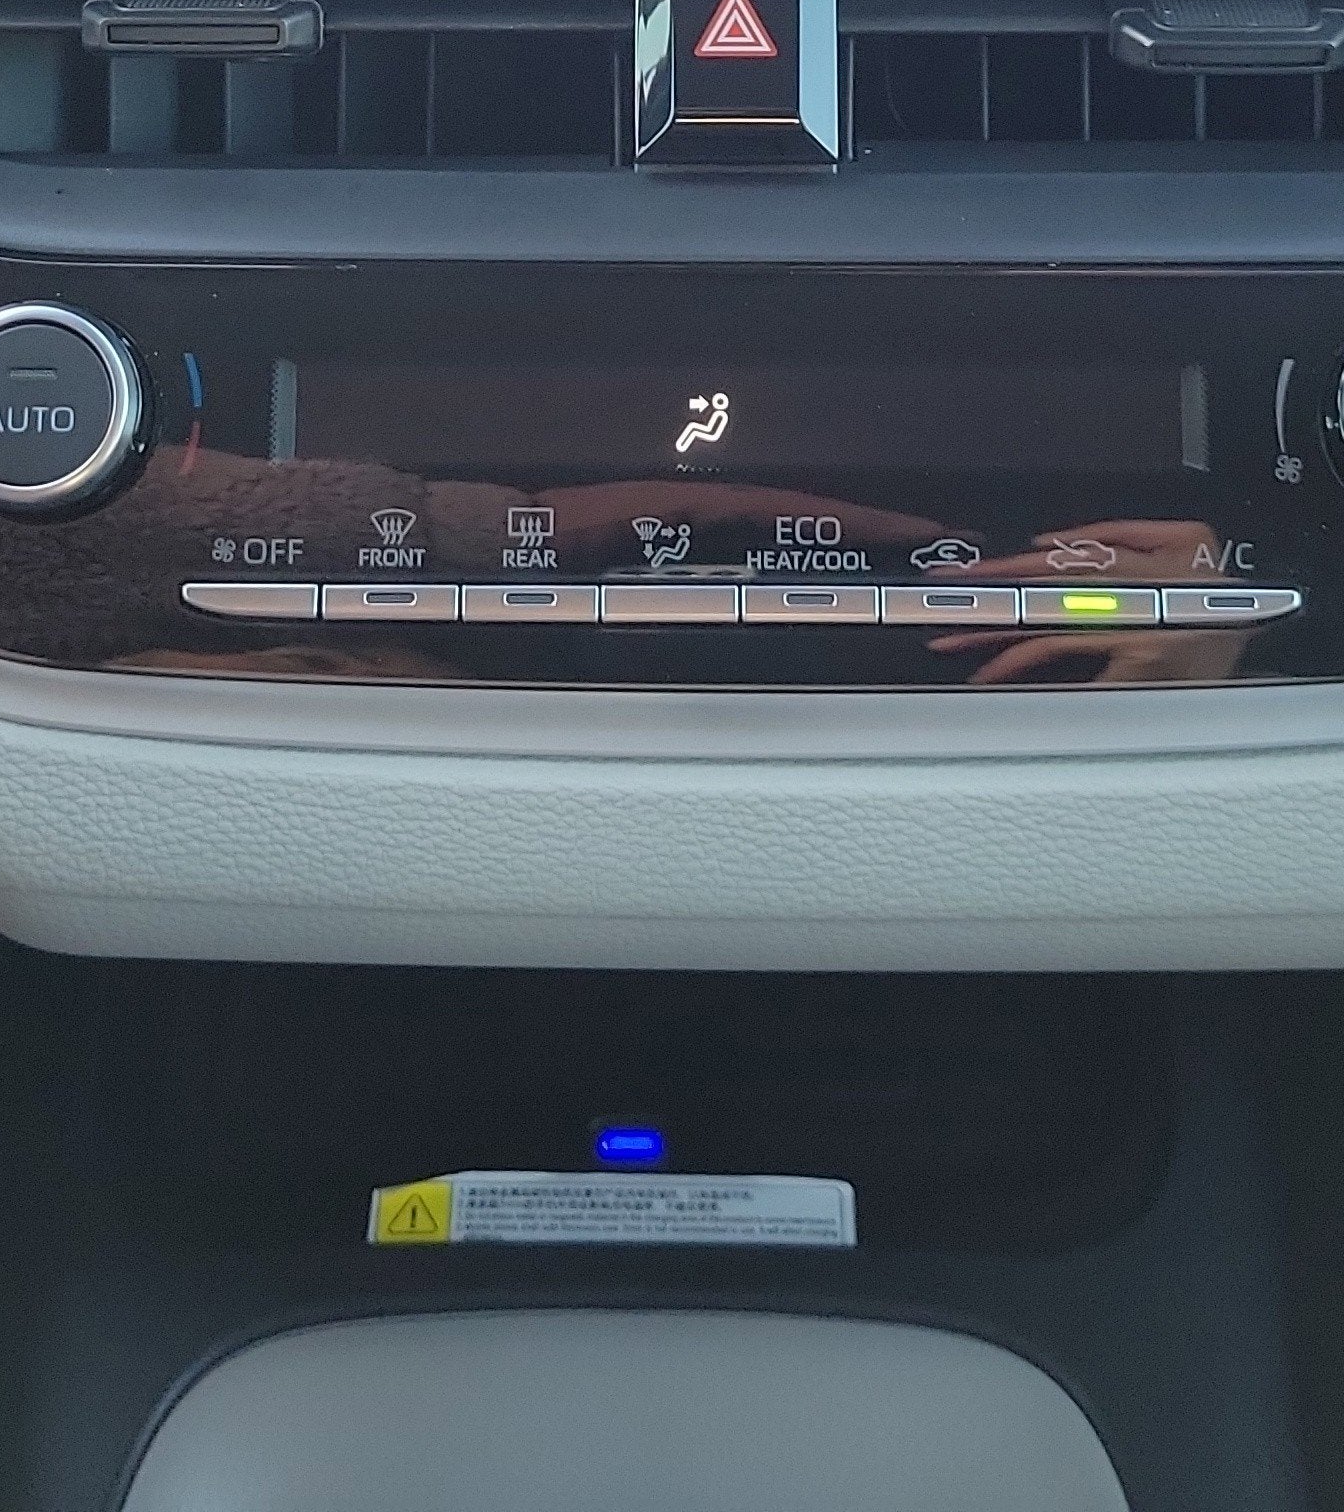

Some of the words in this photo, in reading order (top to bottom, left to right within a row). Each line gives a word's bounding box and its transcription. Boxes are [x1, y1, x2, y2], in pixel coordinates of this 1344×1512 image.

[775, 515, 842, 546] ECO
[243, 537, 304, 565] OFF
[358, 548, 426, 567] FRONT
[503, 548, 558, 568] REAR
[746, 549, 873, 572] HEAT/COOL
[1191, 539, 1256, 572] A/C
